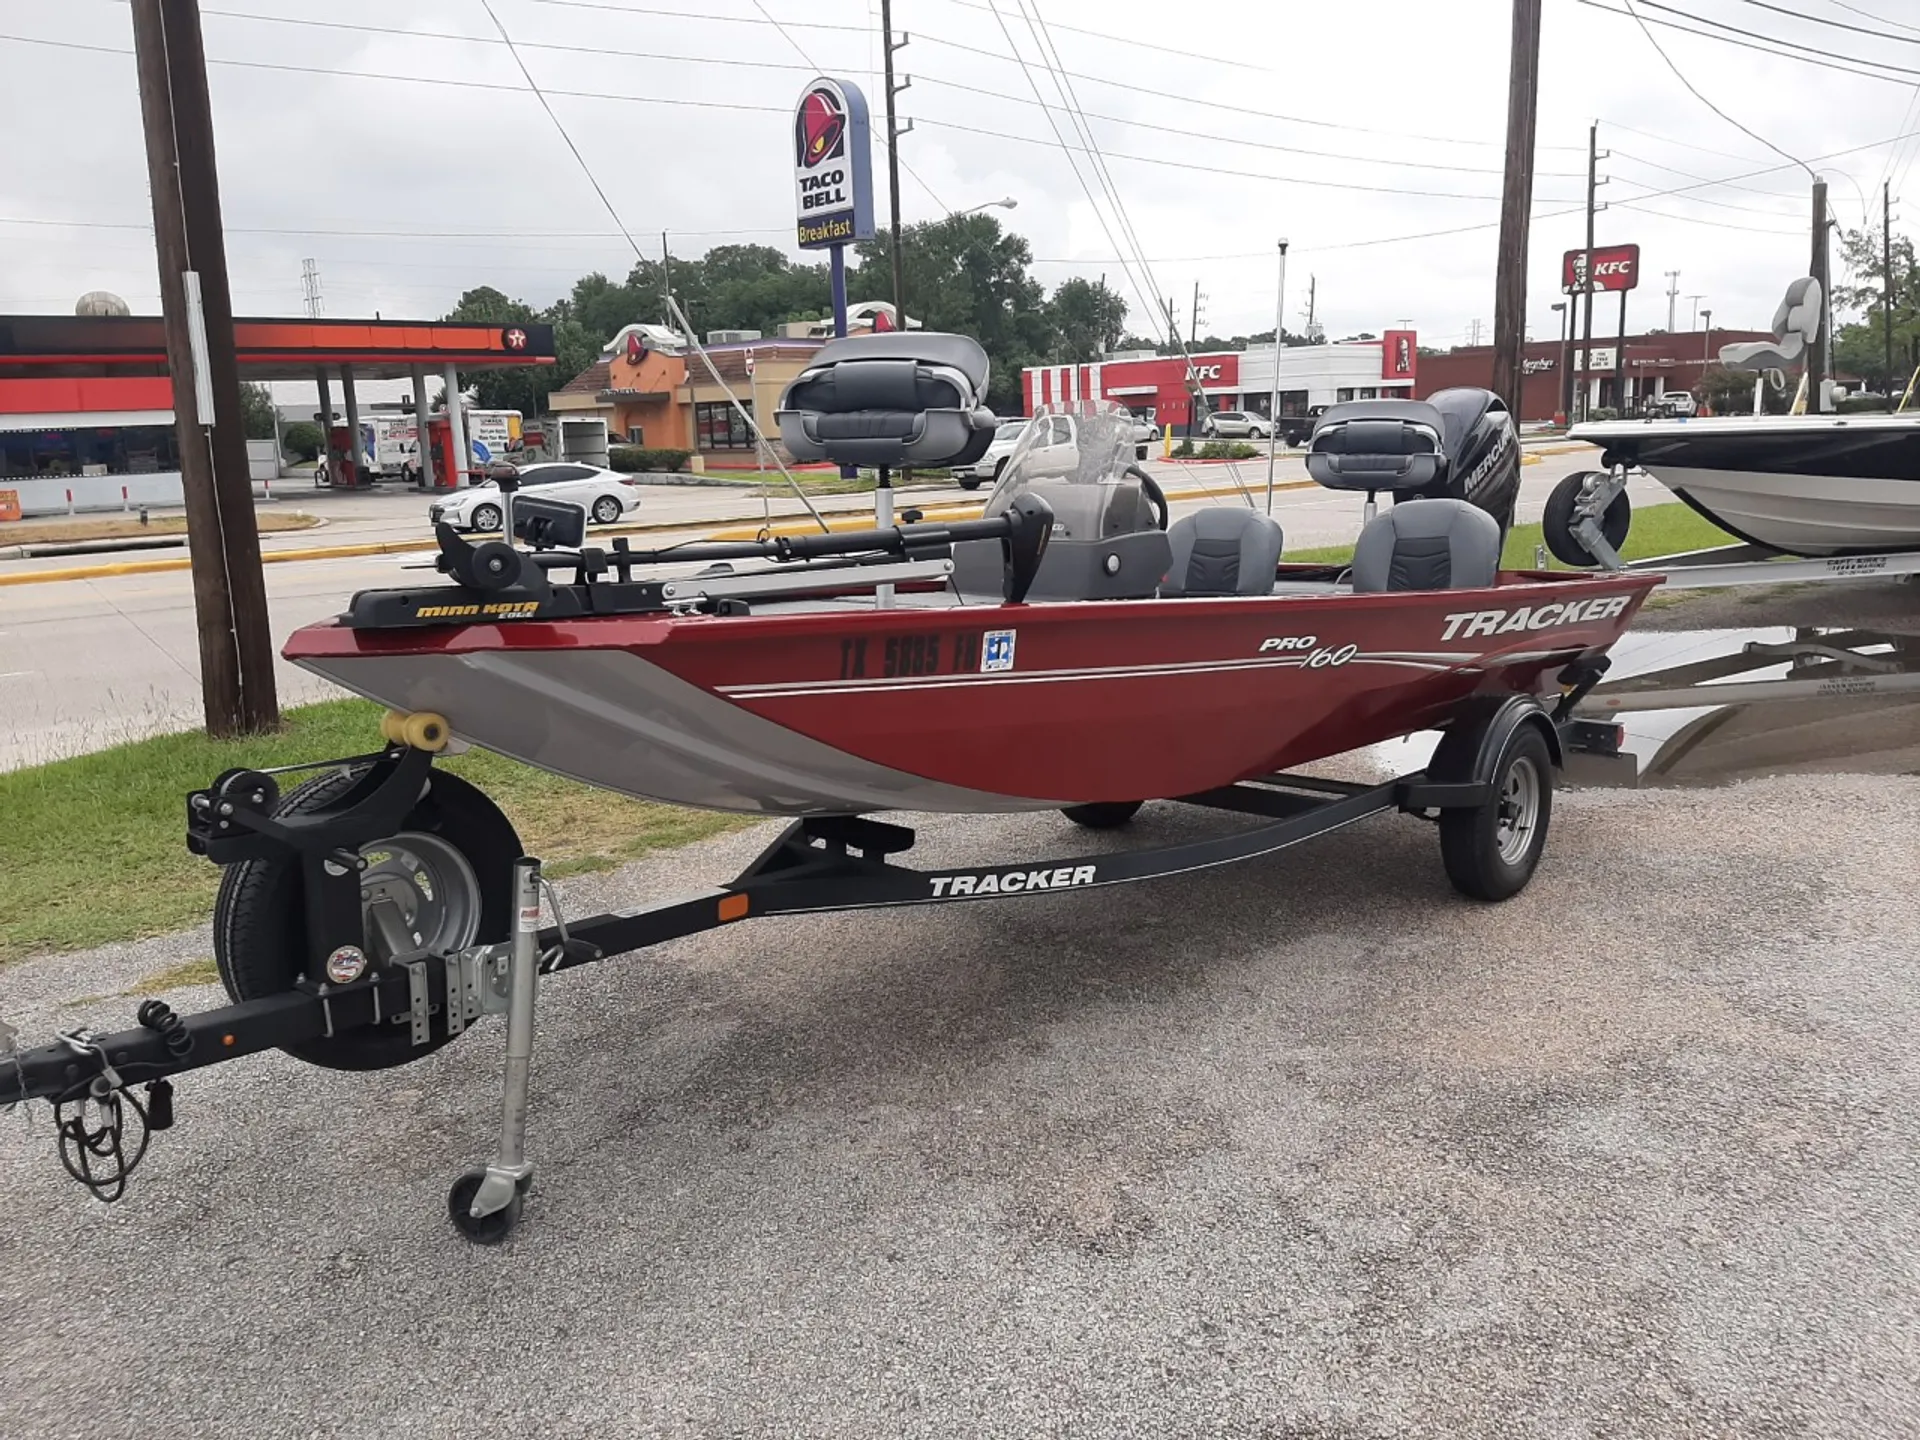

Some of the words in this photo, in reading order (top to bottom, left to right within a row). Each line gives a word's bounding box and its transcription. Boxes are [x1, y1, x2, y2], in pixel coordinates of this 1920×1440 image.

[799, 169, 844, 192] TACO
[802, 188, 846, 210] BELL
[799, 219, 851, 243] Breakfast
[1594, 261, 1632, 276] KFC
[1185, 364, 1222, 381] KFC
[482, 601, 540, 614] KOTA
[1440, 595, 1632, 642] TRACKER
[1258, 635, 1317, 652] PRO
[1298, 644, 1358, 669] 160
[929, 865, 1097, 897] TRACKER
